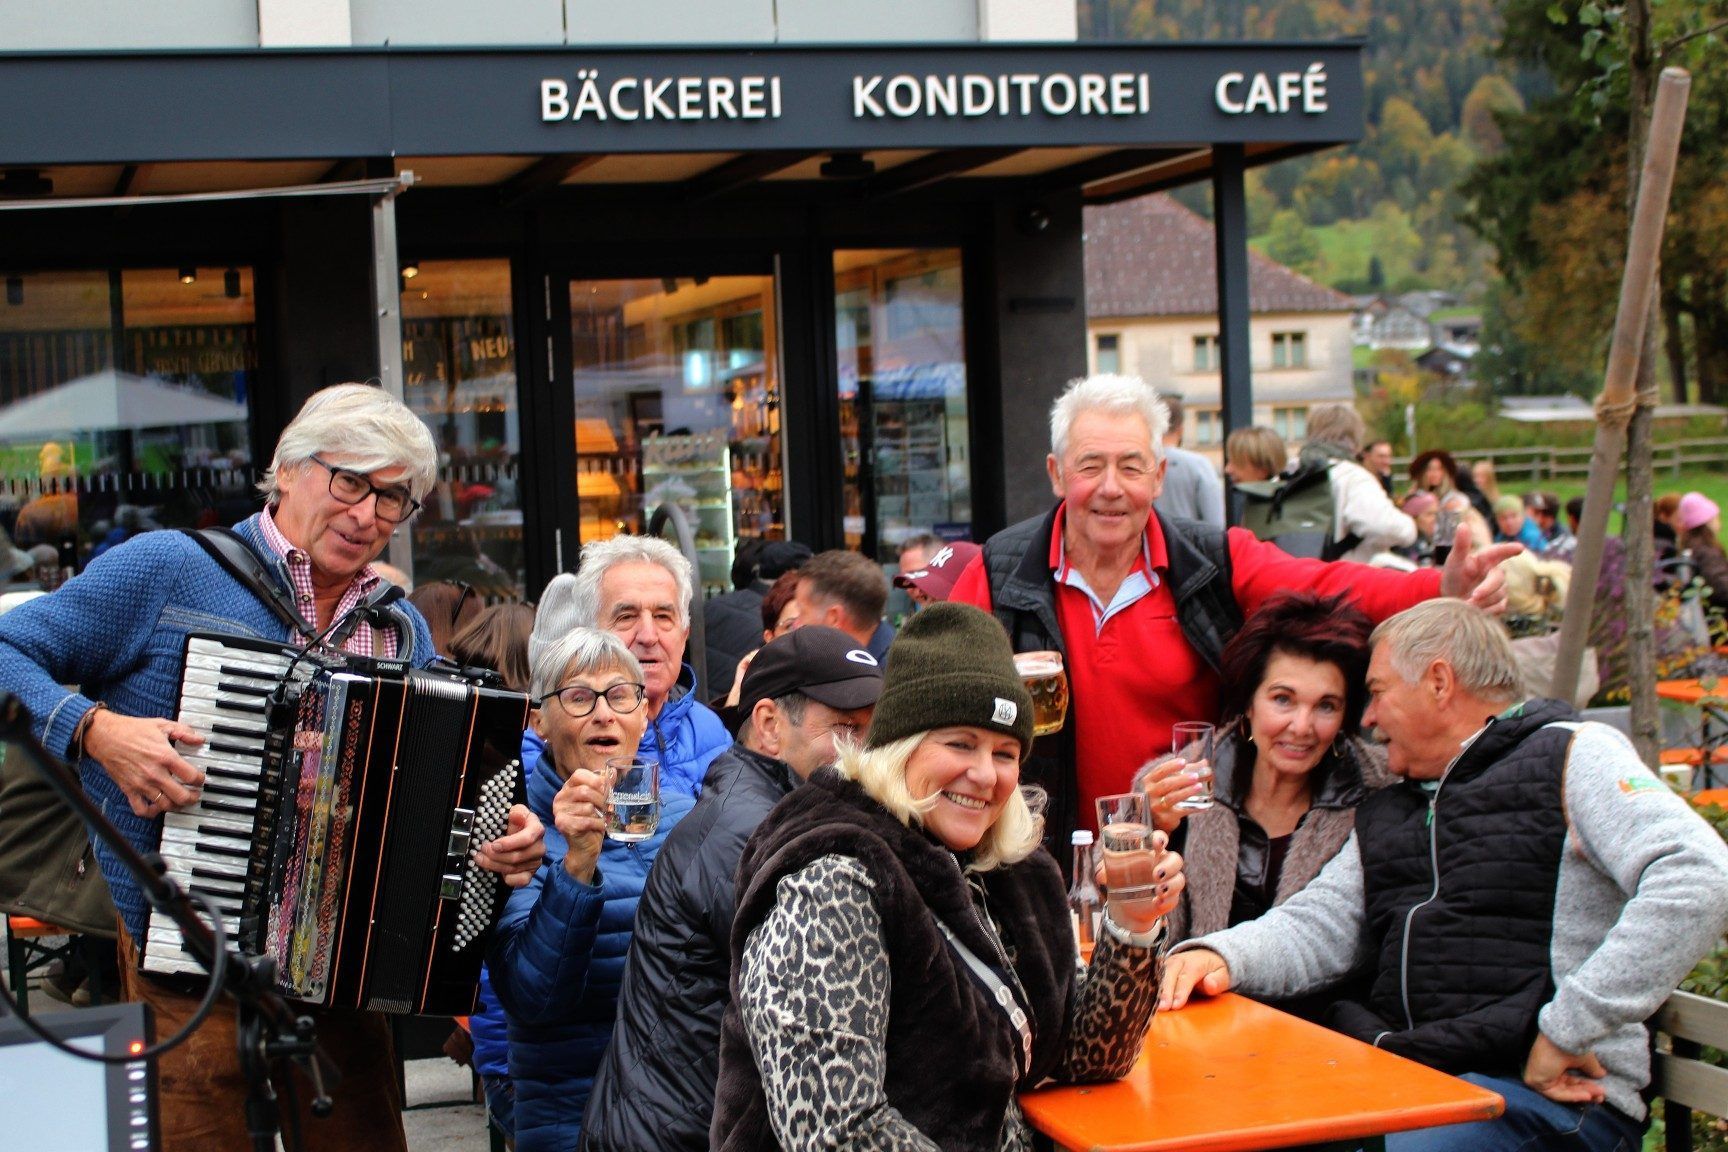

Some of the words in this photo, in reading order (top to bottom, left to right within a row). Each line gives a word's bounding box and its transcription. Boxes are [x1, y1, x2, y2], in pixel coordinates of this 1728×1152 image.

[540, 68, 782, 122] BÄCKEREI
[852, 72, 1150, 118] KONDITOREI
[1214, 61, 1329, 115] CAFÉ
[377, 661, 403, 671] SCHWARZ
